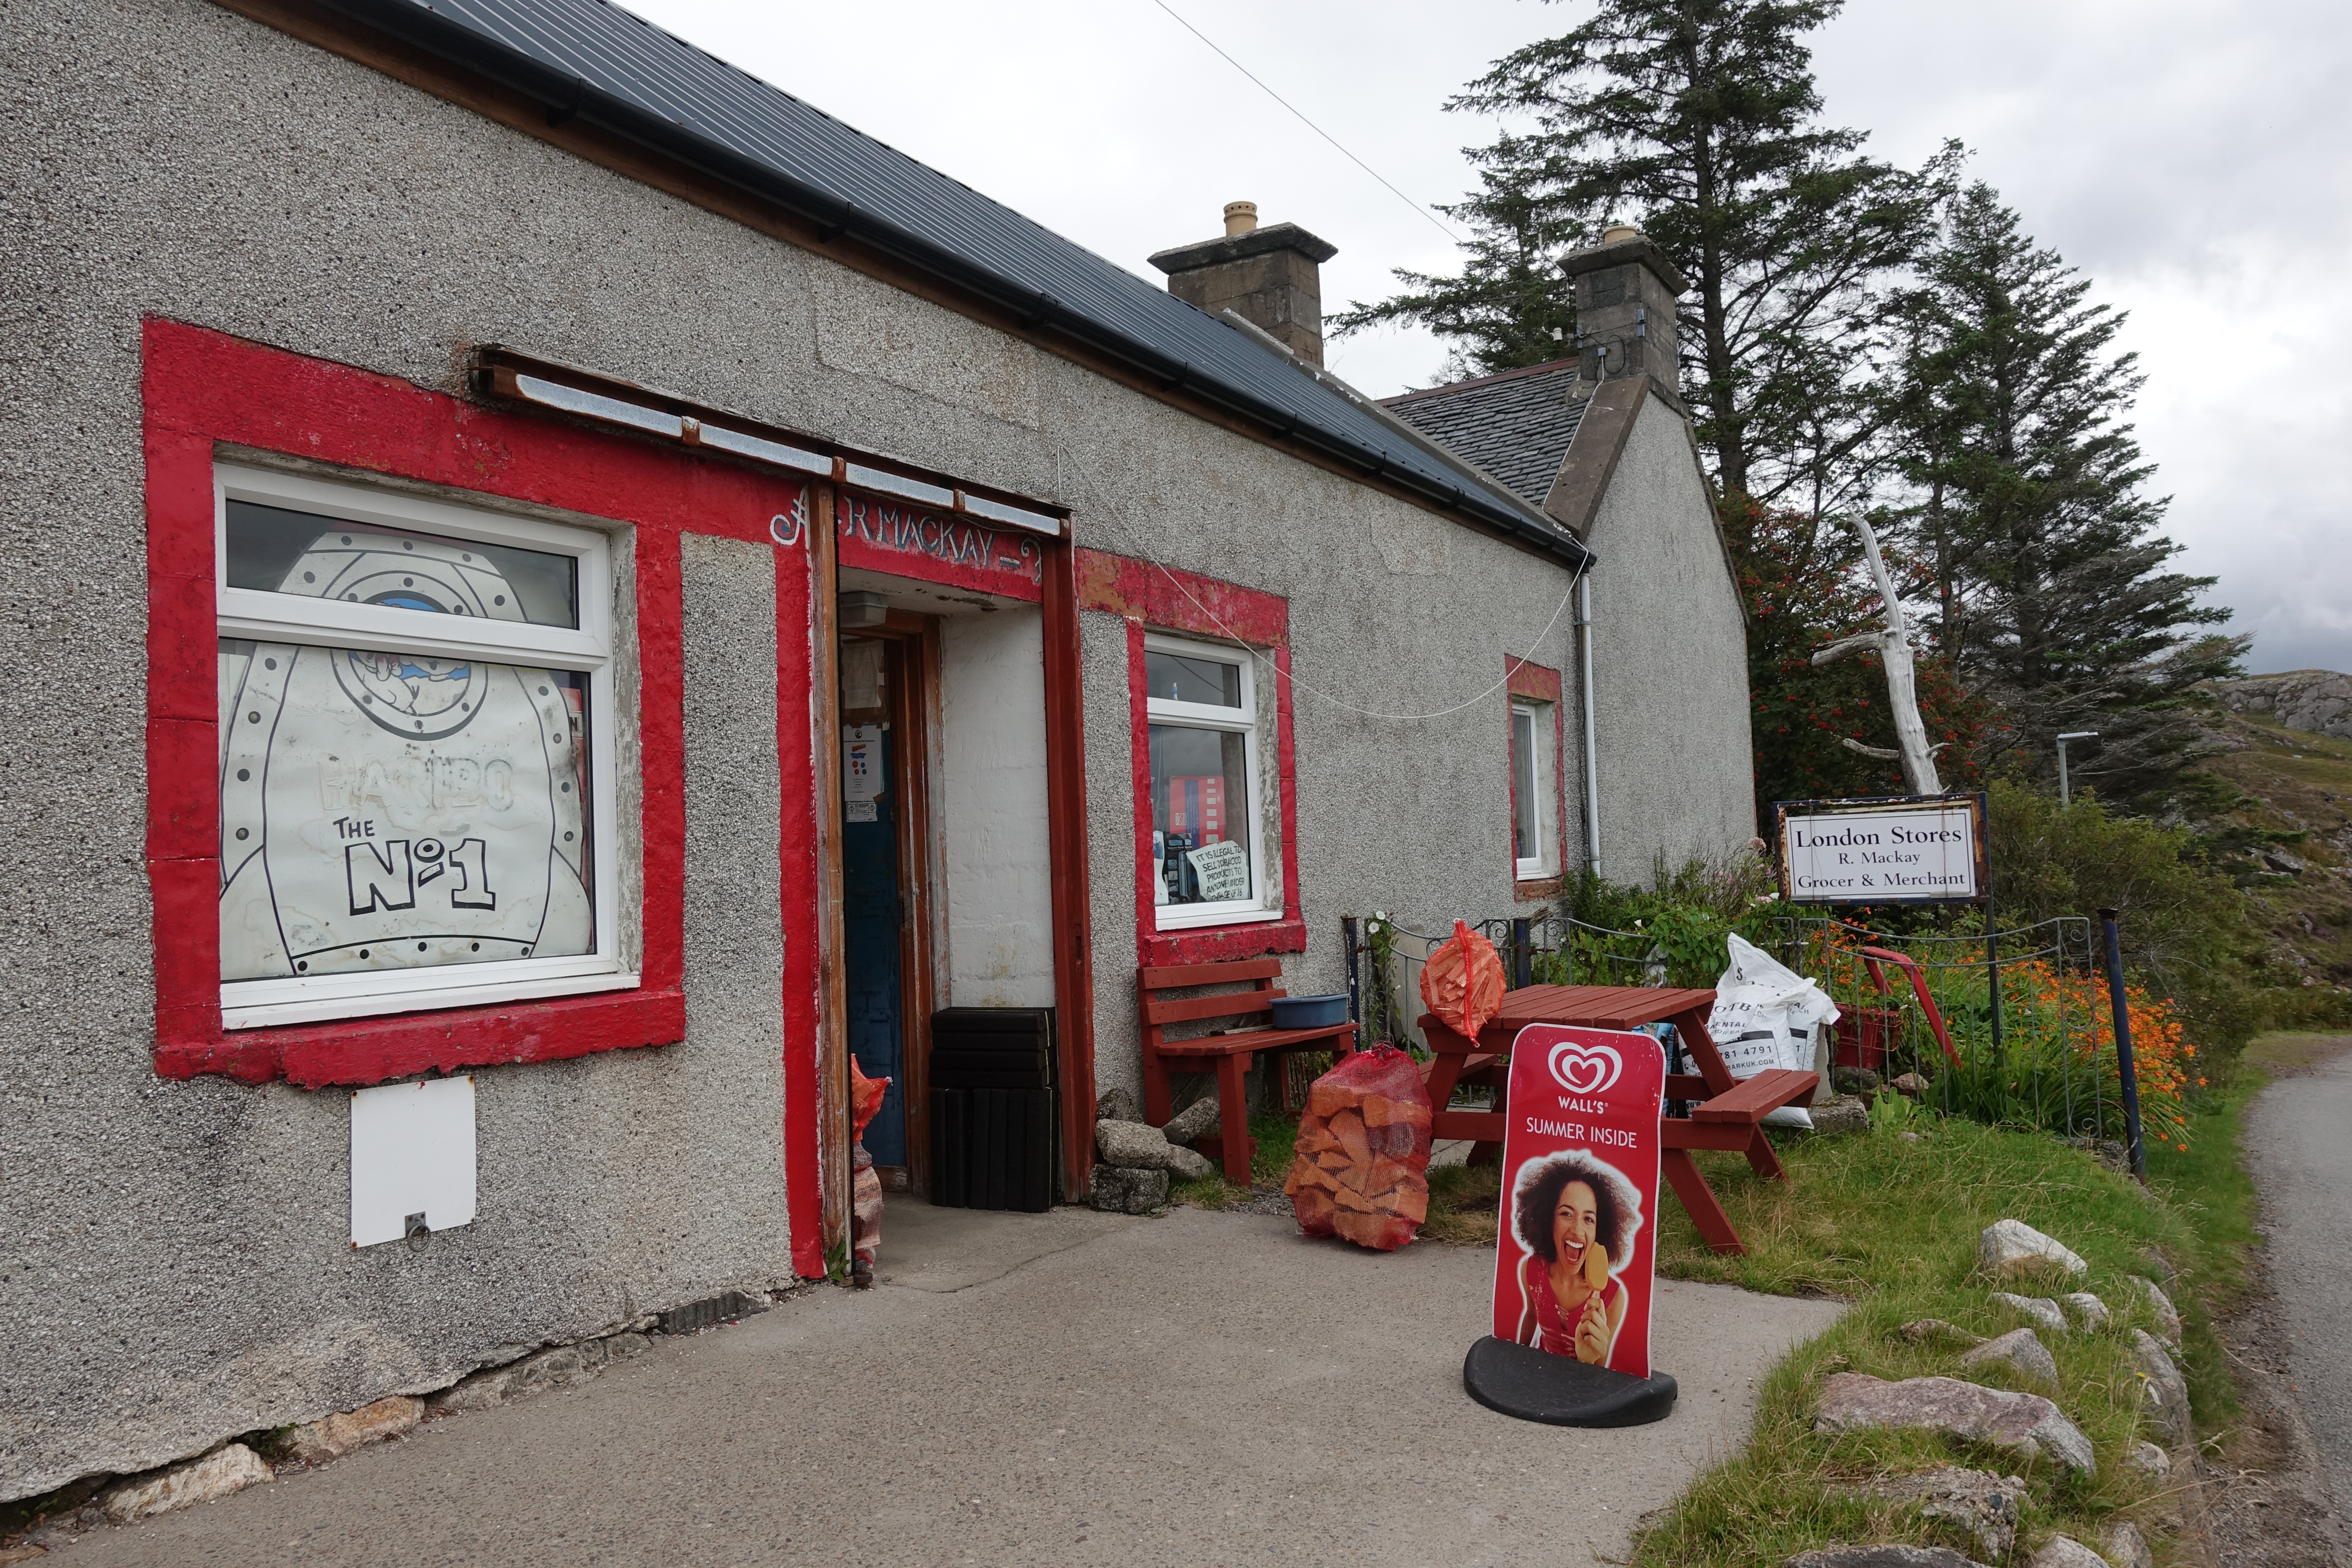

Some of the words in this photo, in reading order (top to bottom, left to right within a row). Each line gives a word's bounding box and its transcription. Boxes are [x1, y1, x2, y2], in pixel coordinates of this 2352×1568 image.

[318, 753, 514, 812] HARIBO
[1795, 827, 1881, 848] London
[1891, 826, 1962, 845] Stores
[1196, 854, 1205, 862] IT
[1205, 851, 1213, 859] IS
[1213, 847, 1234, 858] ILLEGAL
[1234, 845, 1242, 854] TO
[1838, 853, 1854, 864] R.
[1861, 850, 1920, 865] Mackay
[1203, 861, 1217, 872] SELL
[1217, 856, 1241, 868] TOBACCO
[1207, 868, 1234, 882] PRODUCTS
[1234, 867, 1242, 875] TO
[1228, 877, 1245, 887] UNDER
[1798, 875, 1854, 888] Grocer
[1862, 874, 1876, 886] &
[1883, 871, 1965, 886] Merchant
[1743, 1046, 1771, 1055] 4791
[1727, 1059, 1774, 1070] BARKUK.COM
[1526, 1117, 1585, 1140] SUMMER
[1590, 1126, 1637, 1148] INSIDE
